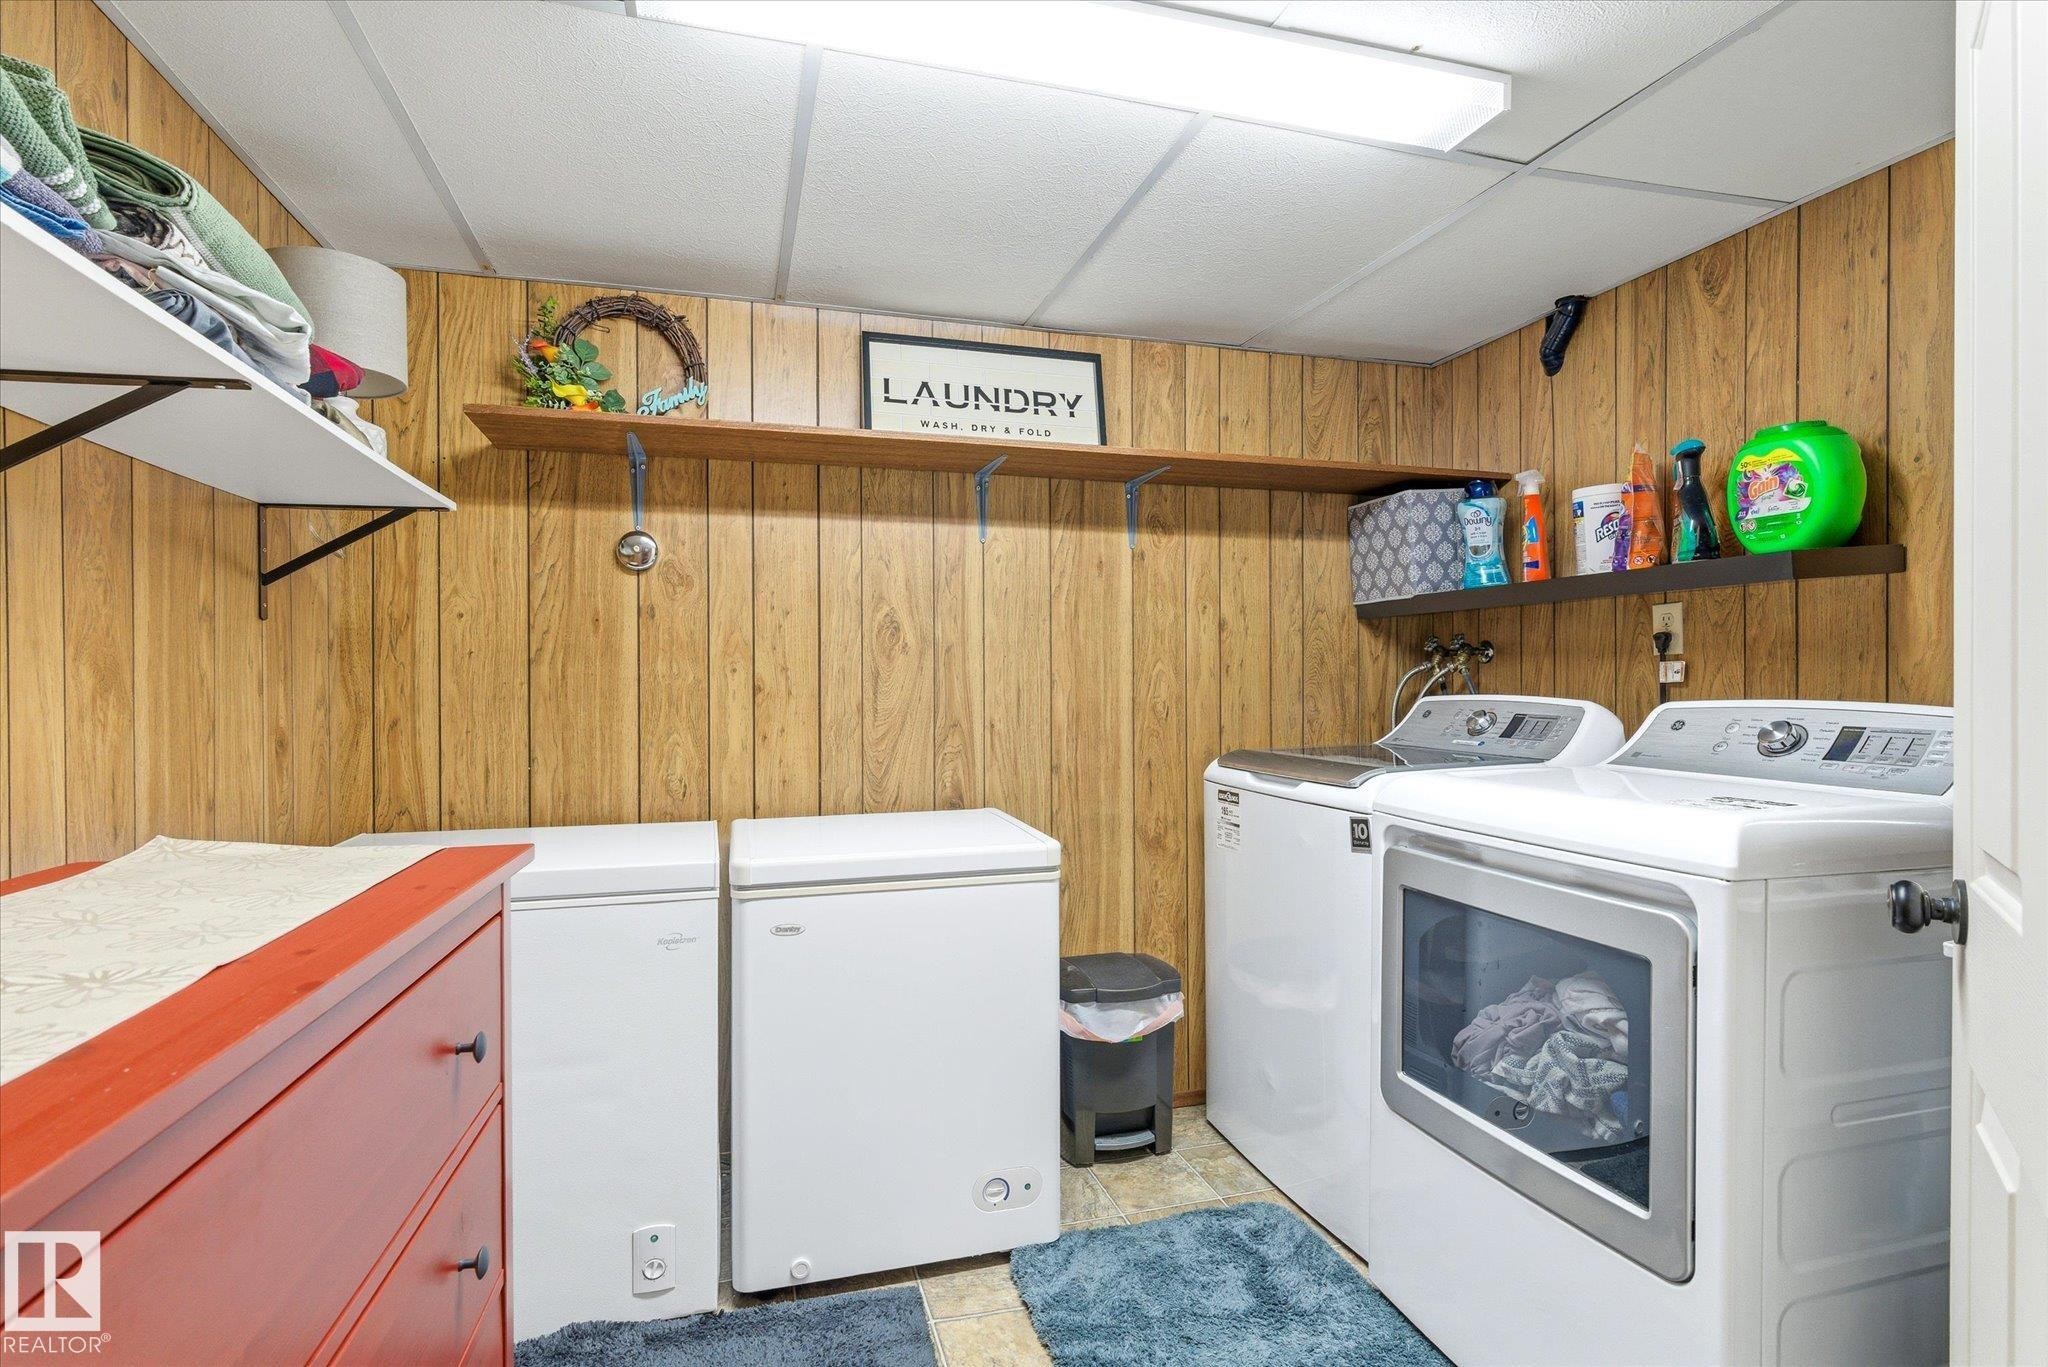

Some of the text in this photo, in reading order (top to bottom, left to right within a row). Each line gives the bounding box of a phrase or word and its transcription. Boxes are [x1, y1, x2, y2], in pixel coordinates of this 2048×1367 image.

[637, 376, 707, 415] Family
[883, 377, 1083, 418] LAUNDRY
[971, 424, 996, 433] DRY
[1004, 426, 1011, 434] &
[1019, 428, 1052, 438] FOLD
[1748, 476, 1779, 500] Gain
[1464, 516, 1493, 527] Downy
[1353, 823, 1368, 840] 10
